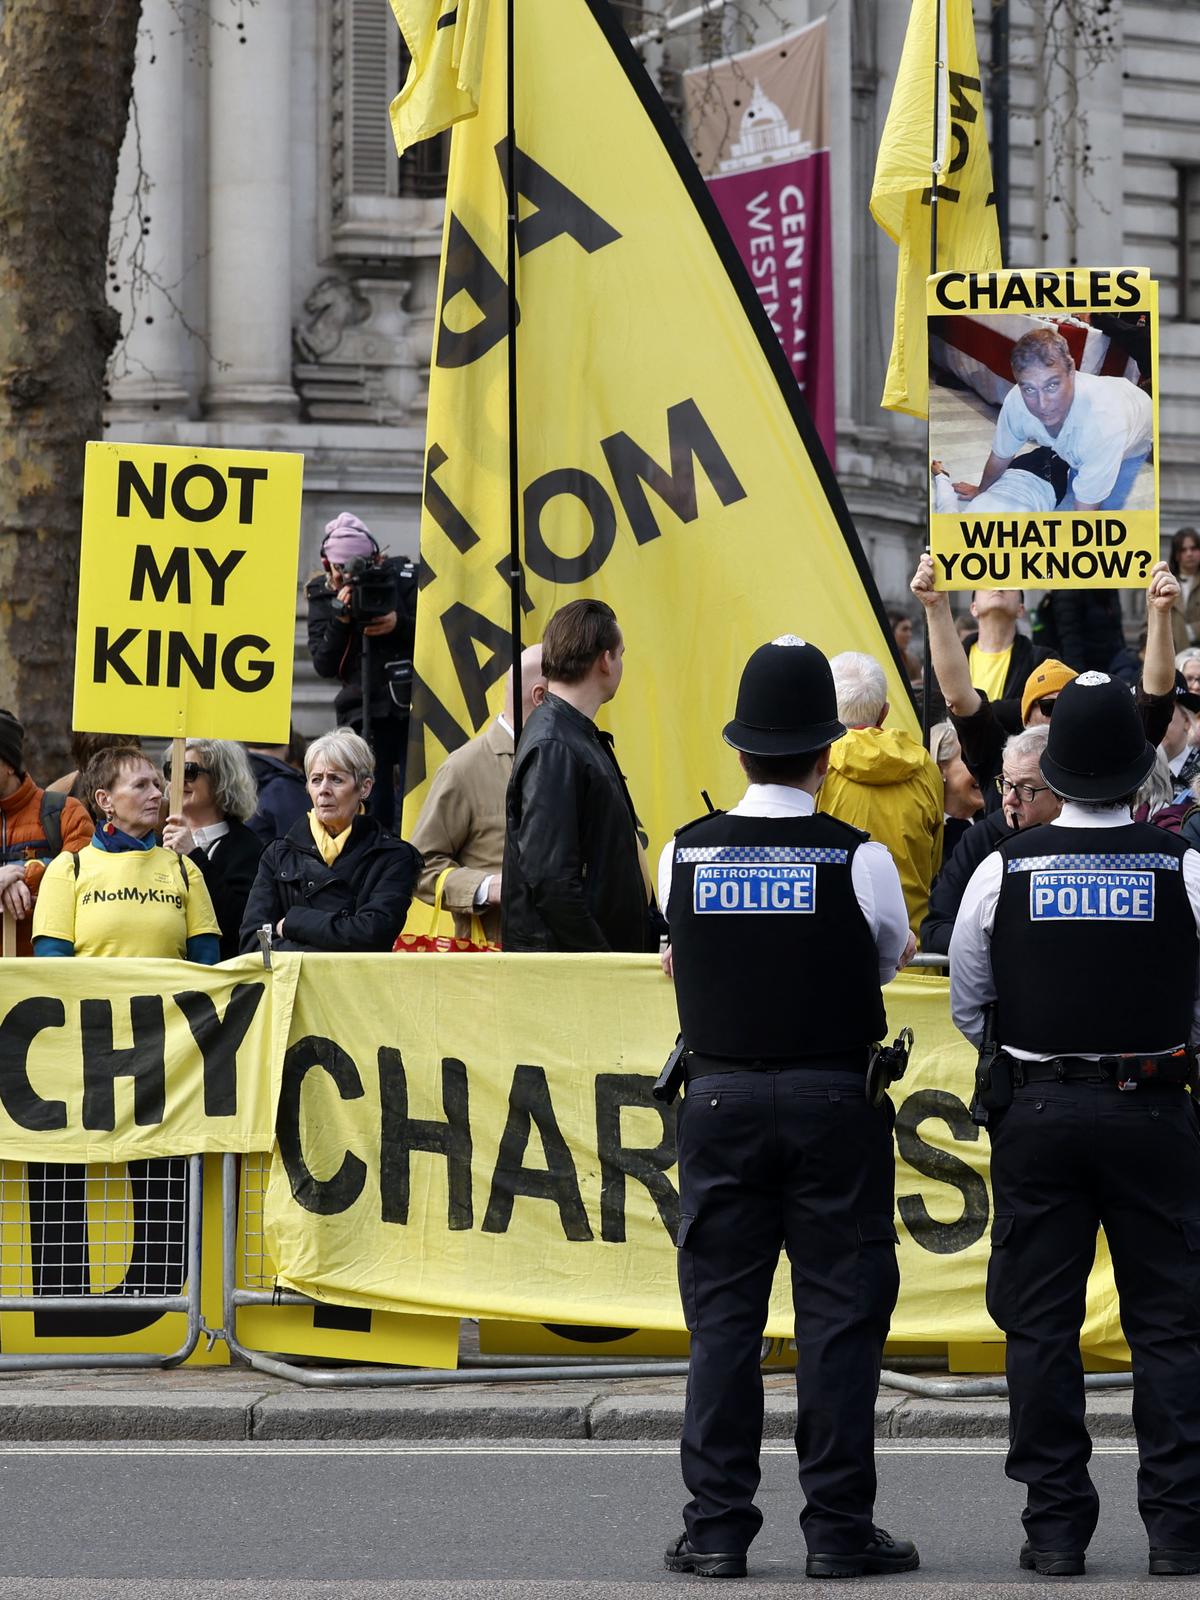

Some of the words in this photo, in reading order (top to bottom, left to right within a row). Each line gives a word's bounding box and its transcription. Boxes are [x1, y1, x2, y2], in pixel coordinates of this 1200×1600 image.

[935, 269, 1142, 311] CHARLES
[116, 460, 268, 525] NOT
[960, 520, 1062, 549] WHAT
[1072, 519, 1127, 547] DID
[129, 544, 247, 606] MY
[936, 552, 1010, 581] YOU
[1021, 550, 1152, 580] KNOW?
[93, 626, 275, 693] KING
[699, 869, 811, 879] METROPOLITAN
[1035, 876, 1149, 886] METROPOLITAN
[82, 887, 183, 909] #NotMyKing
[700, 881, 810, 909] POLICE
[1036, 887, 1149, 916] POLICE
[0, 982, 265, 1131] CHY
